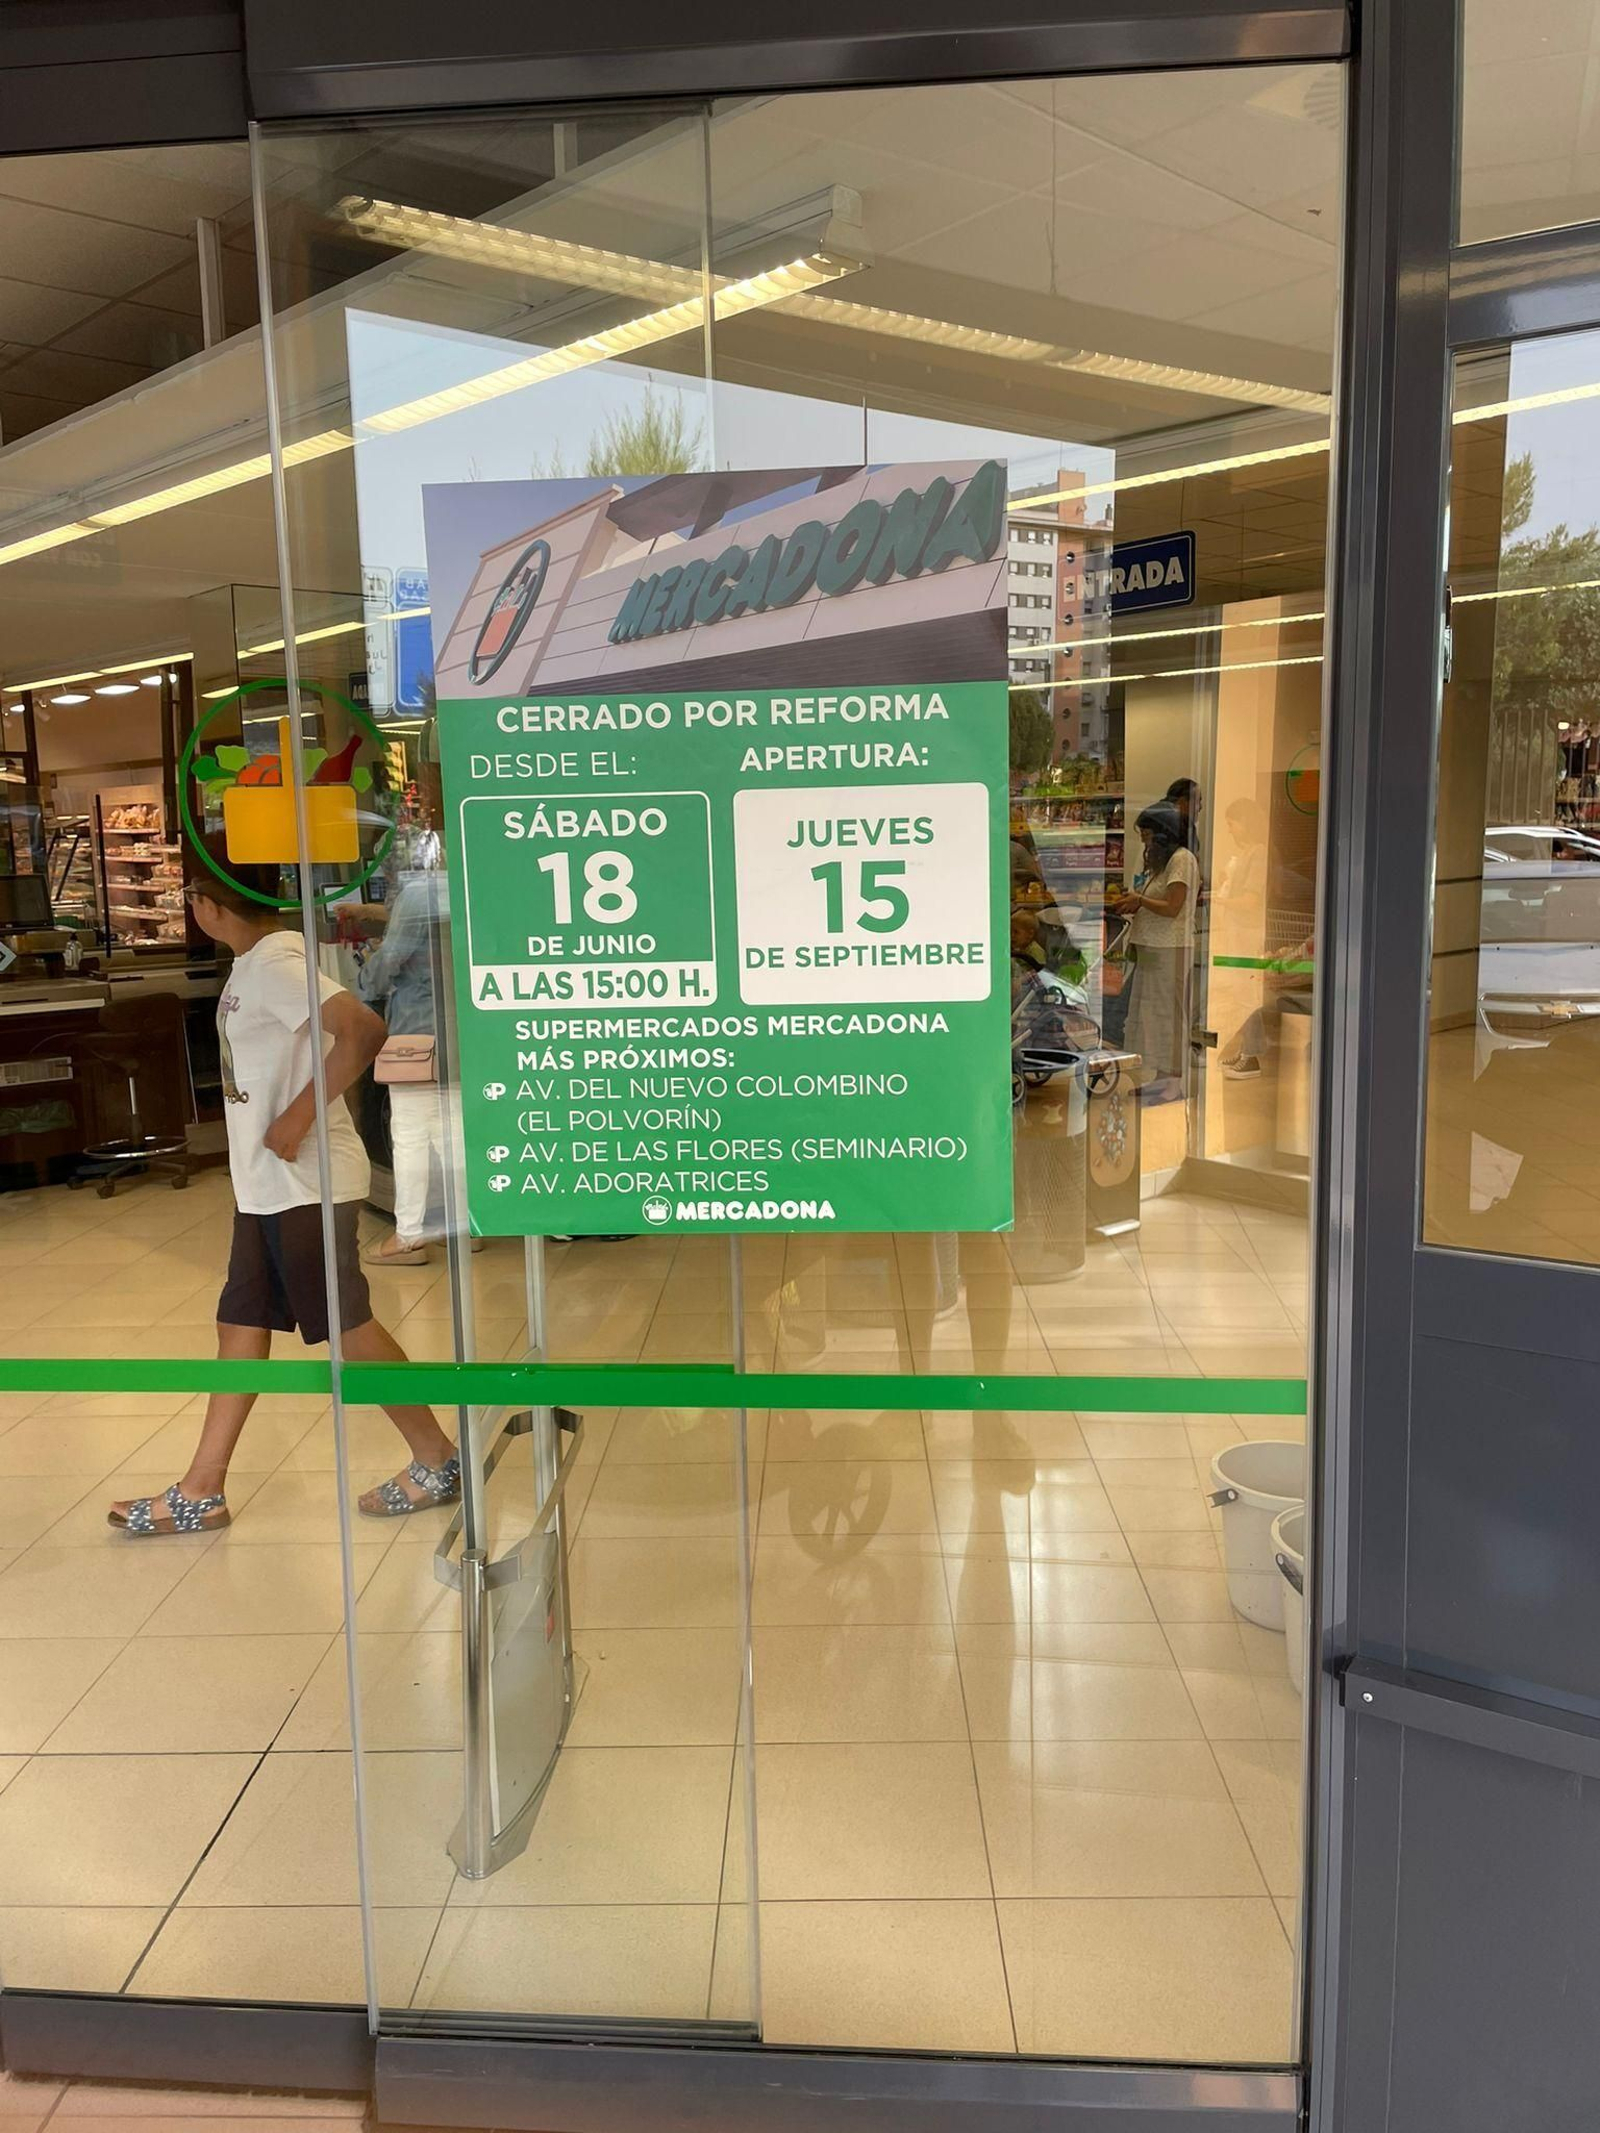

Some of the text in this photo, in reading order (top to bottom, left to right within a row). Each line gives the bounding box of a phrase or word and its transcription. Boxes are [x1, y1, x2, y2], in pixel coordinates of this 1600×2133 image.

[607, 460, 1004, 644] MERCADONA
[496, 693, 950, 733] CERRADO POR REFORMA
[470, 751, 636, 779] DESDE EL:
[739, 742, 929, 772] APERTURA:
[504, 802, 668, 840] SÁBADO
[786, 816, 934, 849] JUEVES
[537, 850, 638, 925] 18
[810, 859, 910, 934] 15
[527, 933, 656, 956] DE JUNIO
[745, 942, 984, 969] DE SEPTIEMBRE
[478, 968, 710, 1002] A LAS 15:00 H.
[515, 1013, 950, 1041] SUPERMERCADOS MERCADONA
[517, 1043, 735, 1071] MÁS PRÓXIMOS:
[516, 1079, 561, 1101] AV.
[569, 1078, 622, 1100] DEL
[629, 1076, 728, 1099] NUEVO
[736, 1073, 908, 1098] COLOMBINO
[517, 1102, 722, 1135] (EL POLVORÍN)
[519, 1142, 564, 1163] AV.
[572, 1141, 609, 1163] DE
[616, 1140, 669, 1162] LAS
[676, 1138, 783, 1161] FLORES
[791, 1136, 968, 1163] (SEMINARIO)
[520, 1173, 565, 1195] AV.
[573, 1170, 769, 1194] ADORATRICES
[675, 1200, 836, 1221] MERCADONA
